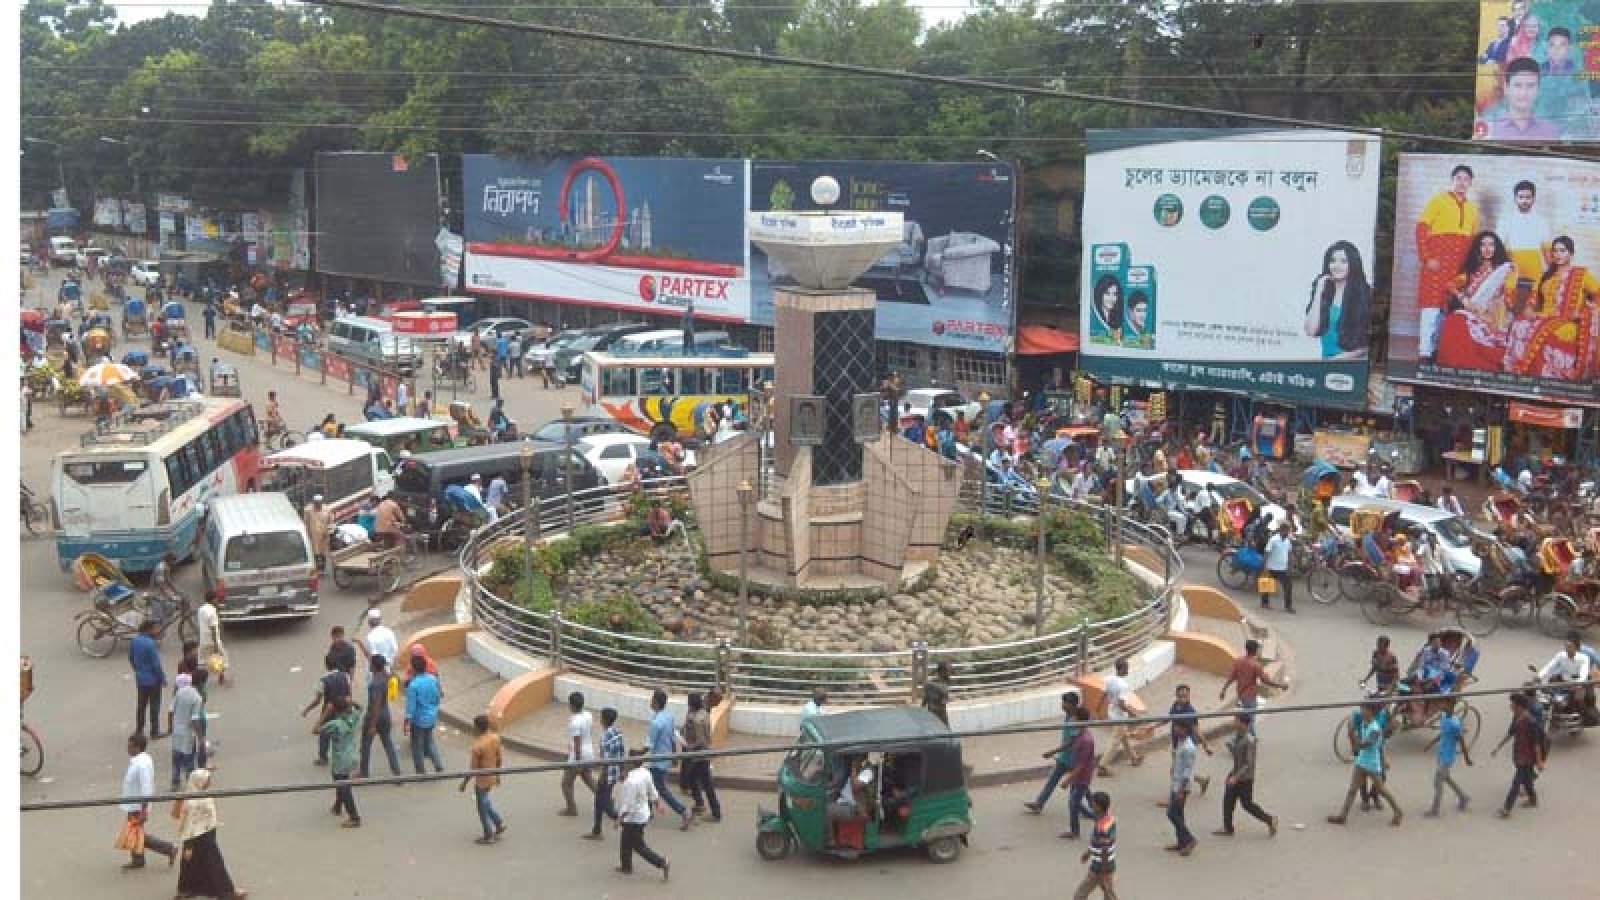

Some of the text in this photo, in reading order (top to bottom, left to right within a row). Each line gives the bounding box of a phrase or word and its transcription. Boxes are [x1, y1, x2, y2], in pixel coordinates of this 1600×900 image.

[1124, 167, 1319, 192] চুলের ড্যামেজকে না বলুন
[483, 185, 541, 216] নিরাপদ
[660, 276, 729, 300] PARTEX
